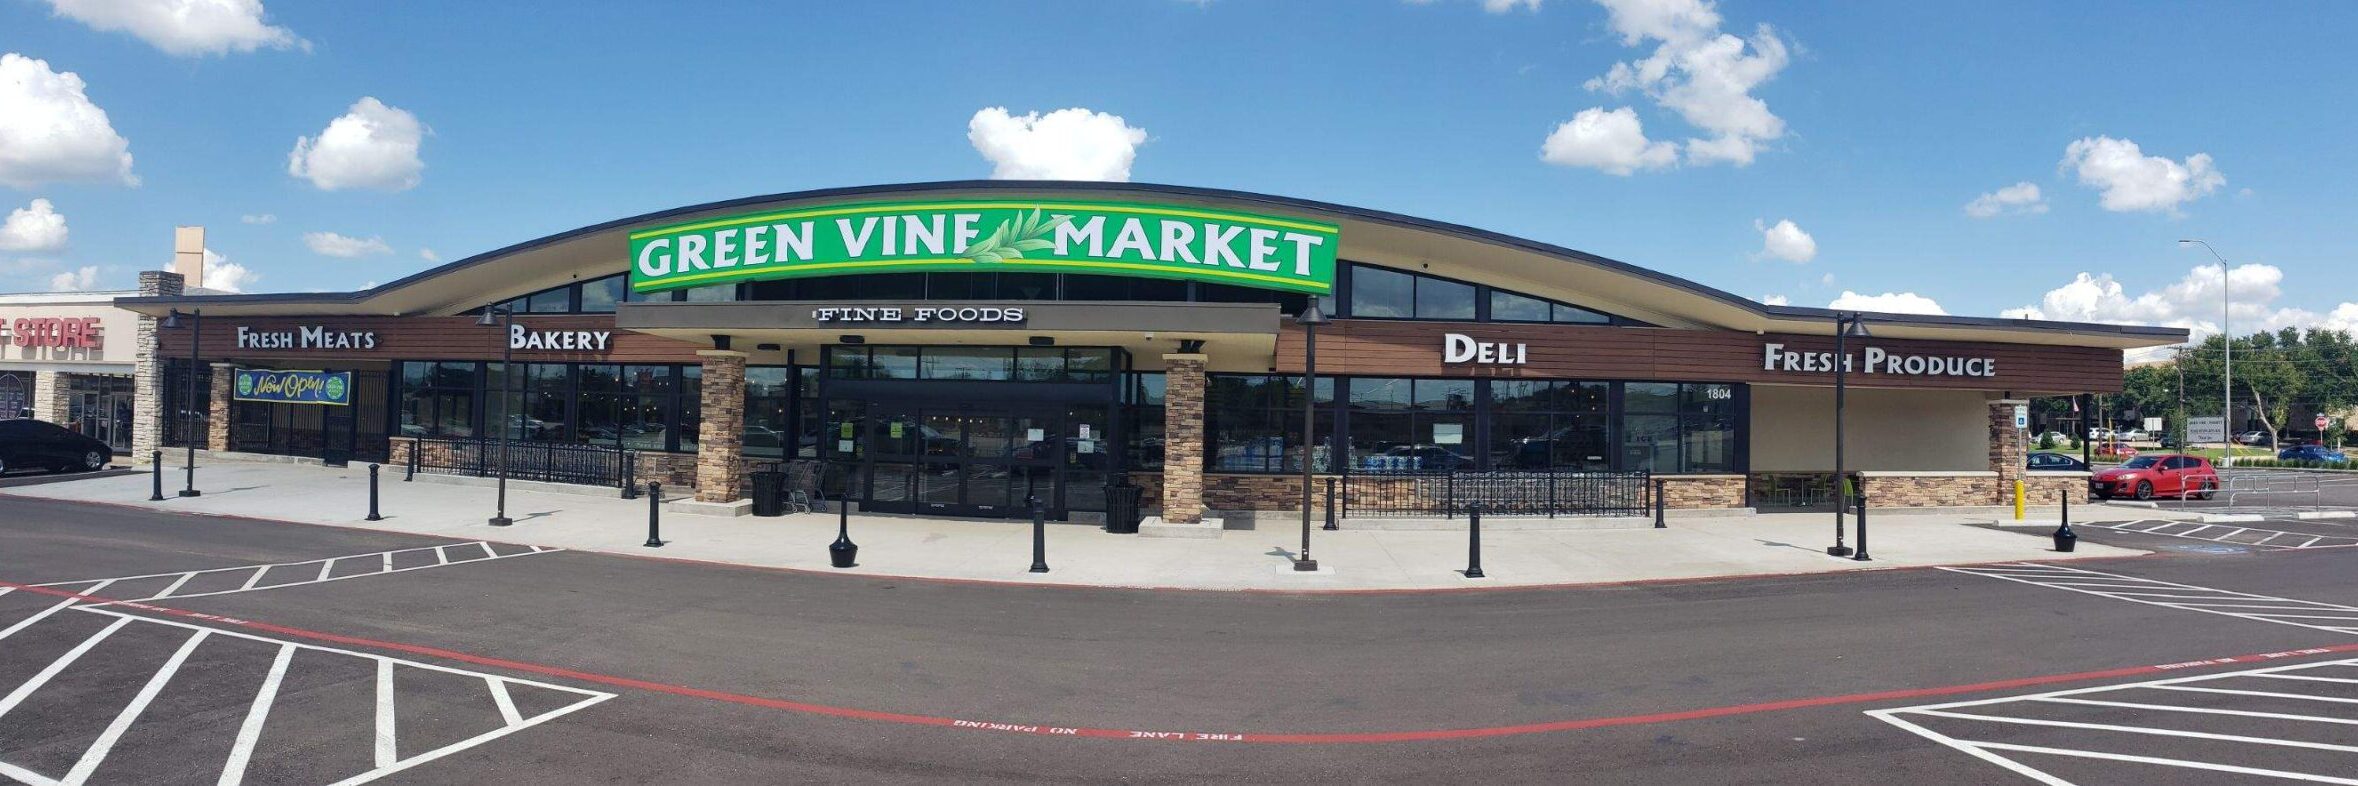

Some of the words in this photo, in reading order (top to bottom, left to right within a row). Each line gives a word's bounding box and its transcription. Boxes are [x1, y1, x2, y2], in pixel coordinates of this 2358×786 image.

[637, 220, 815, 277] GREEN
[835, 213, 983, 258] VINE
[1050, 213, 1324, 277] MARKET
[818, 307, 902, 321] FINE
[914, 307, 1023, 321] FOODS
[13, 317, 102, 348] STORE
[237, 326, 293, 349] FRESH
[299, 325, 375, 349] MEATS
[510, 323, 610, 350] BAKERY
[1444, 333, 1527, 364] DELI
[1764, 343, 1852, 373] FRESH
[1864, 346, 1996, 377] PRODUCE
[253, 374, 286, 396] Now
[1707, 388, 1731, 399] 1804
[952, 719, 1037, 732] PARKING
[1049, 726, 1078, 735] NO
[1129, 730, 1184, 739] LANE
[1196, 733, 1243, 741] FIRE
